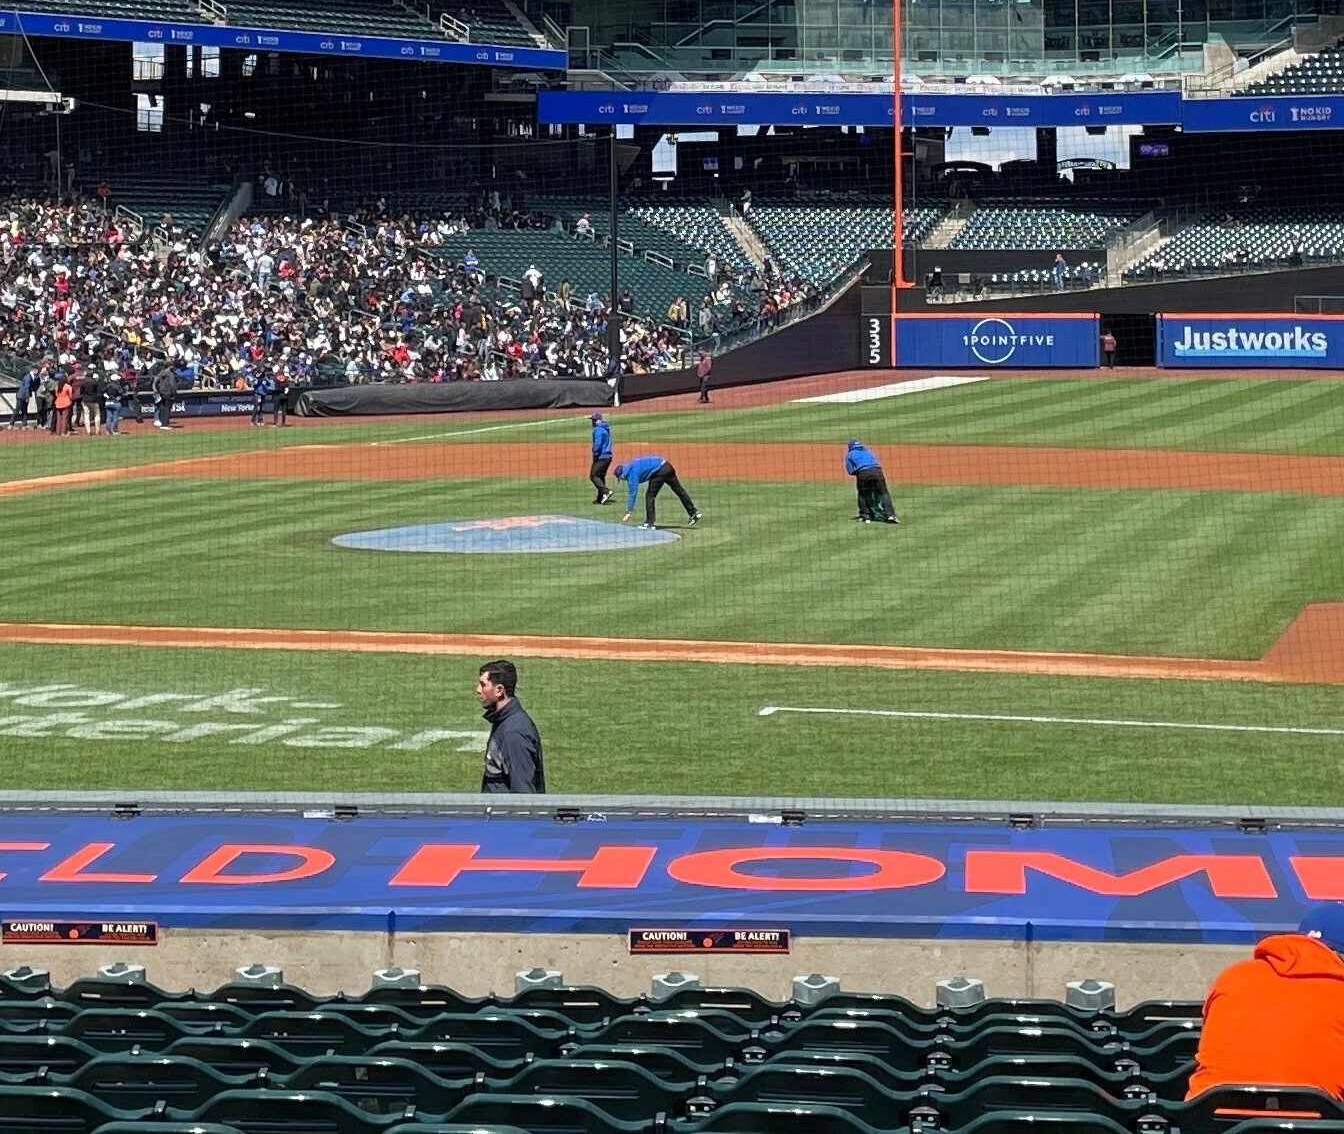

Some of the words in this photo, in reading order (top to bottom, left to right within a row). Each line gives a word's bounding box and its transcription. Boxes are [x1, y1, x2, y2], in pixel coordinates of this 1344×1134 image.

[1249, 109, 1276, 122] citi
[1301, 107, 1314, 115] NO
[1316, 107, 1331, 115] KID
[869, 318, 880, 364] 335
[963, 335, 1054, 346] 1POINTFIVE
[1174, 326, 1328, 351] Justworks
[10, 922, 54, 932] CAUTION!
[102, 924, 114, 932] BE
[116, 924, 147, 933] ALERT!
[642, 932, 688, 940] CAUTION!
[734, 932, 746, 940] BE
[748, 932, 780, 941] ALERT!
